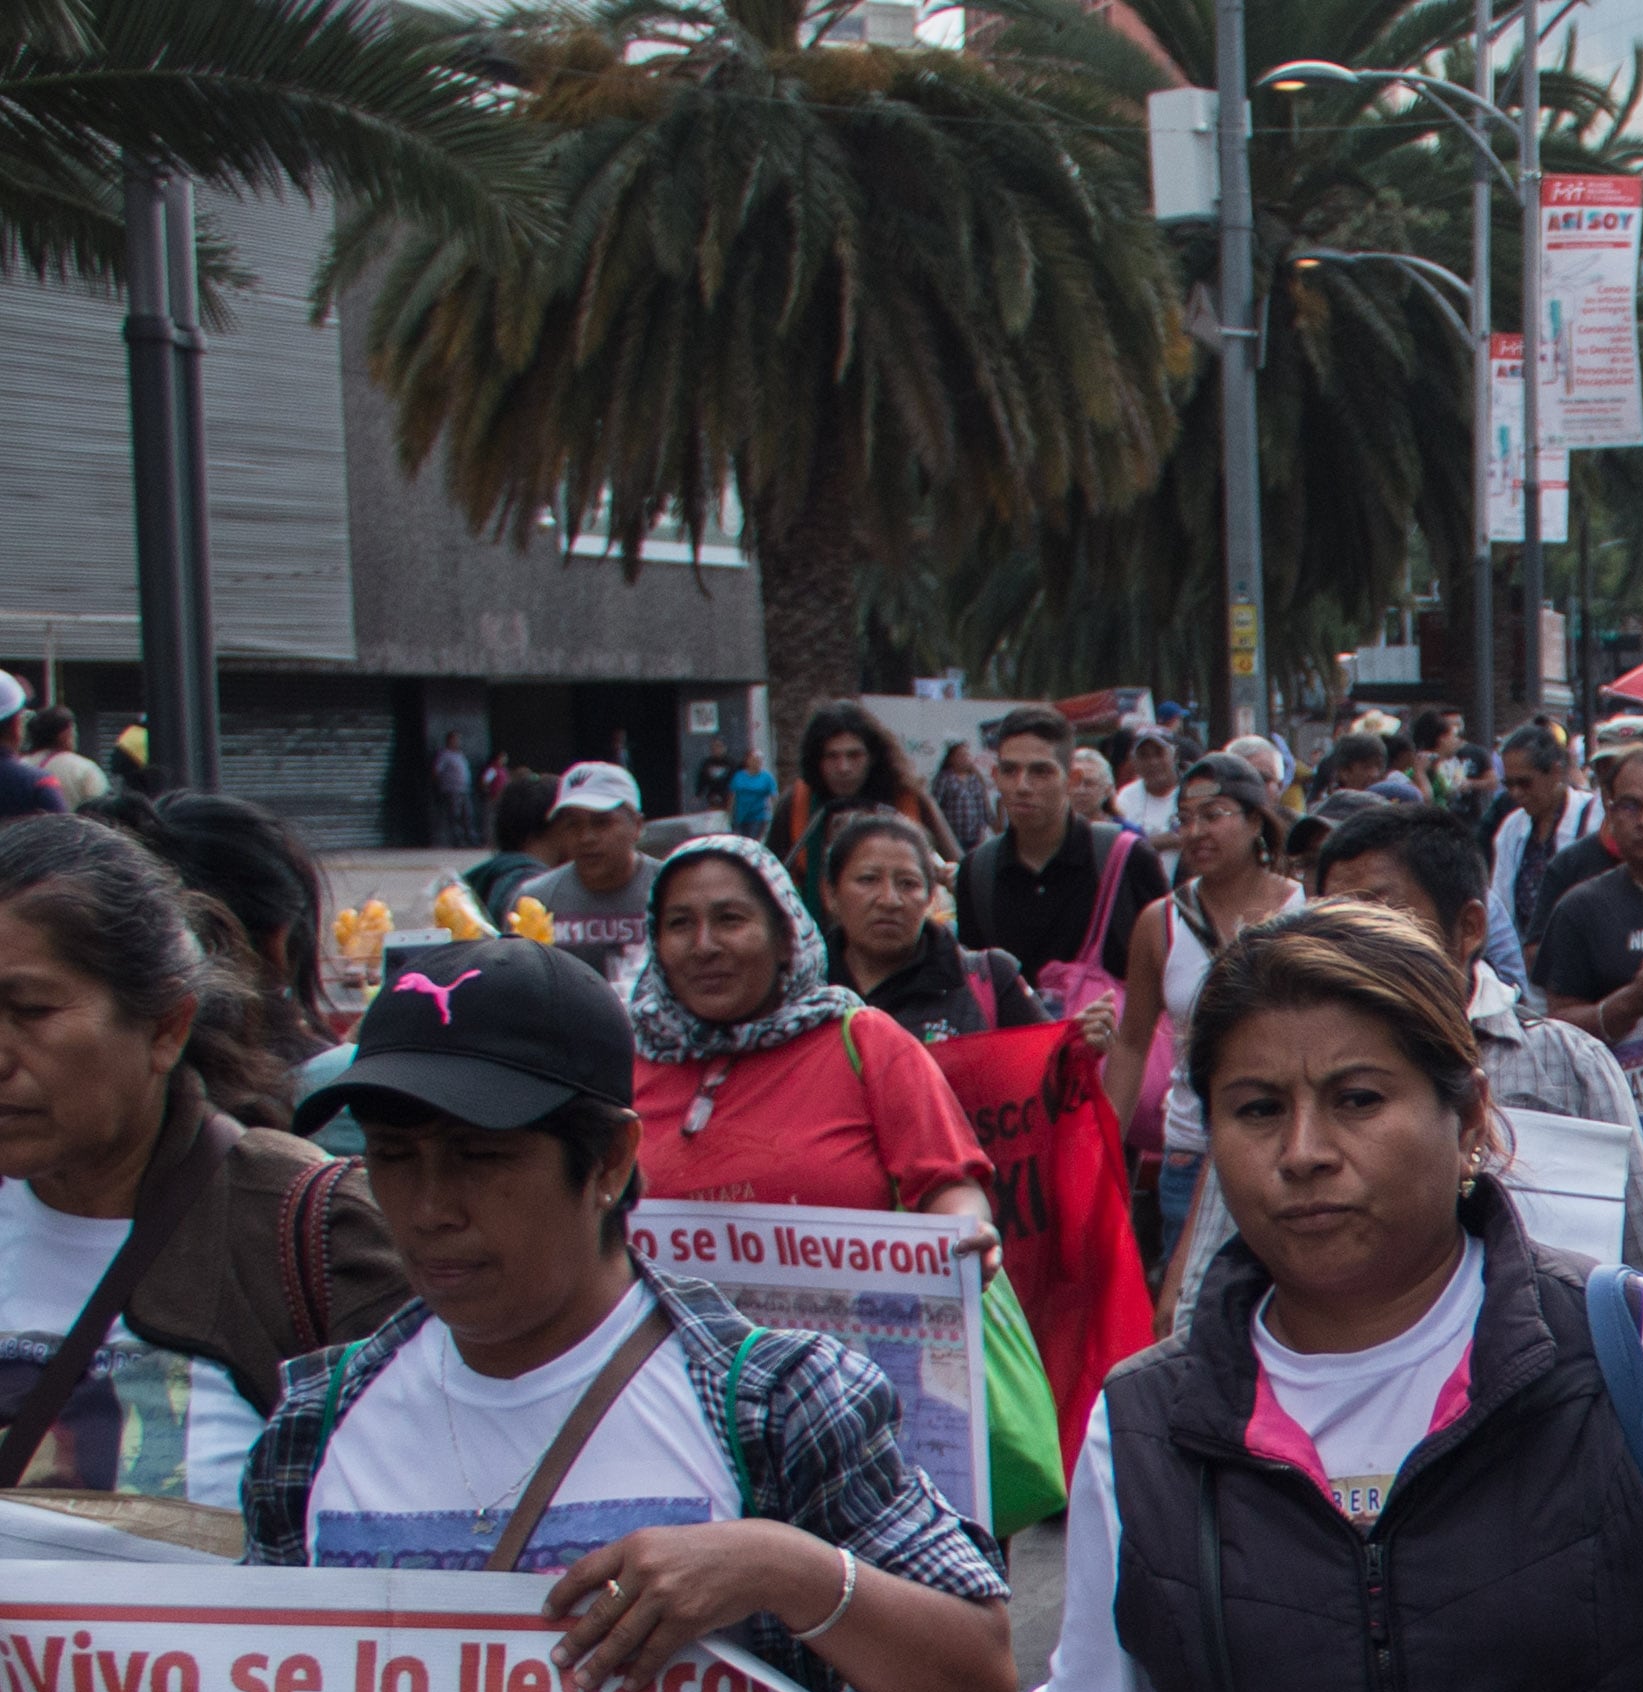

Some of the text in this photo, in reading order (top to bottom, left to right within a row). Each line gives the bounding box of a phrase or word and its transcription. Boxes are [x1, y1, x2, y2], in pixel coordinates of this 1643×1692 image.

[1586, 210, 1634, 231] SOY
[671, 1227, 717, 1263] se
[726, 1222, 765, 1264] lo
[774, 1225, 952, 1277] llevaron!
